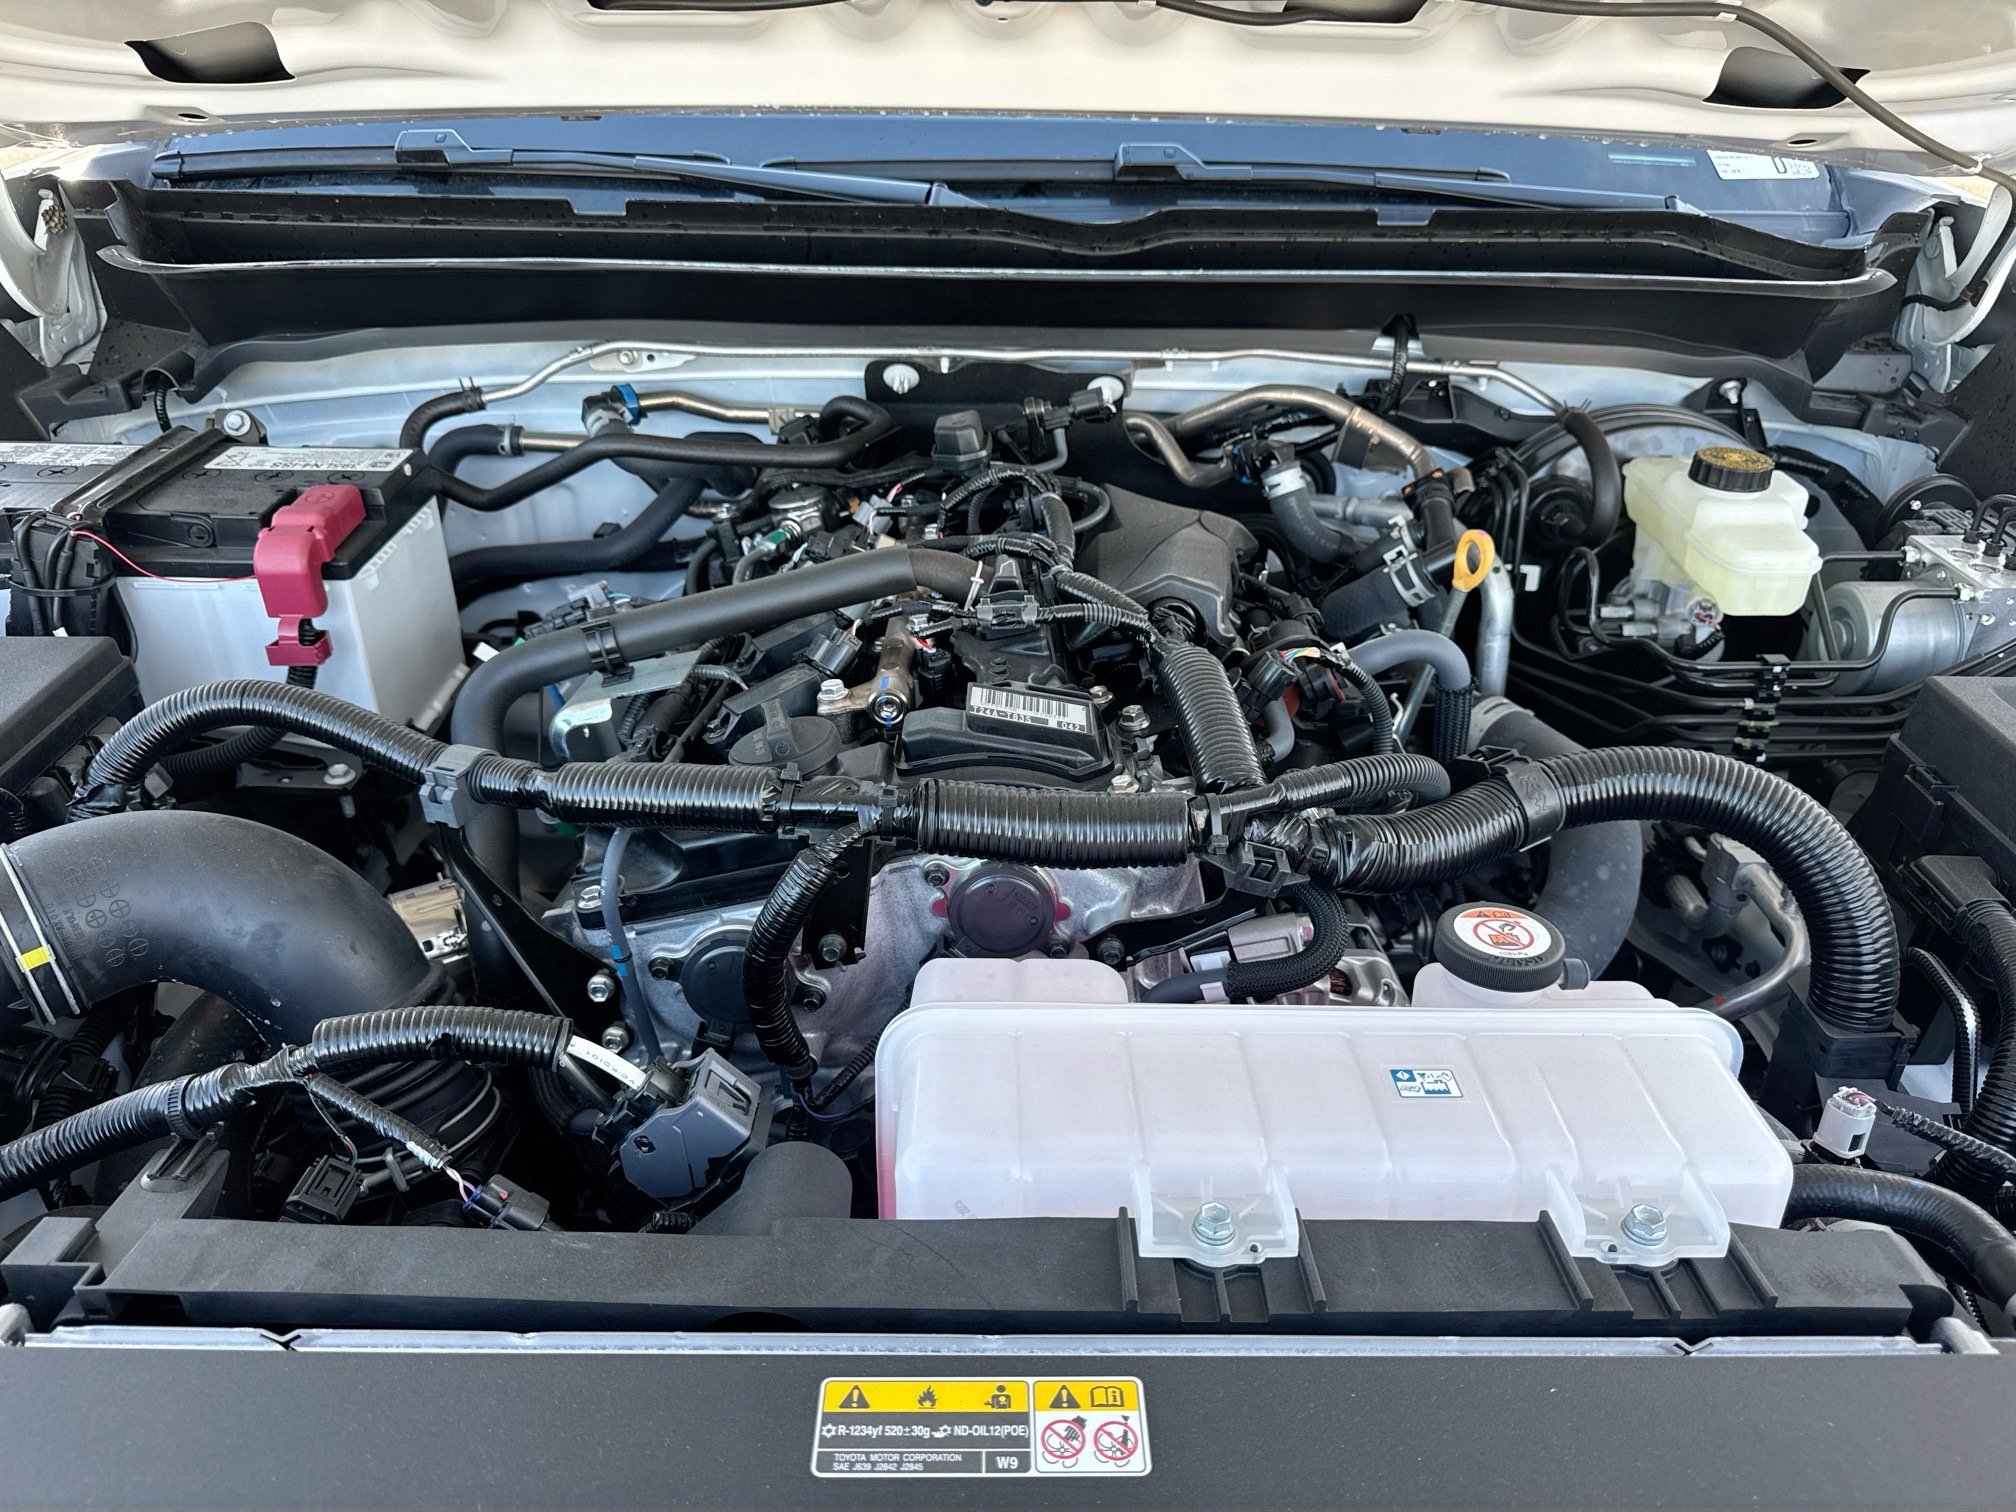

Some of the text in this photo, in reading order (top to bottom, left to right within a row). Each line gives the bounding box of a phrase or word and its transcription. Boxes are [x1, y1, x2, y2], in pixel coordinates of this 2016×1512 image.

[838, 1425, 1029, 1439] R-1234yf 520±30g ND-OIL12(POE)
[834, 1453, 962, 1462] TOYOTA MOTOR CORPORATION
[996, 1456, 1018, 1469] W9
[832, 1463, 923, 1471] SAE J639 J2842 J2845
